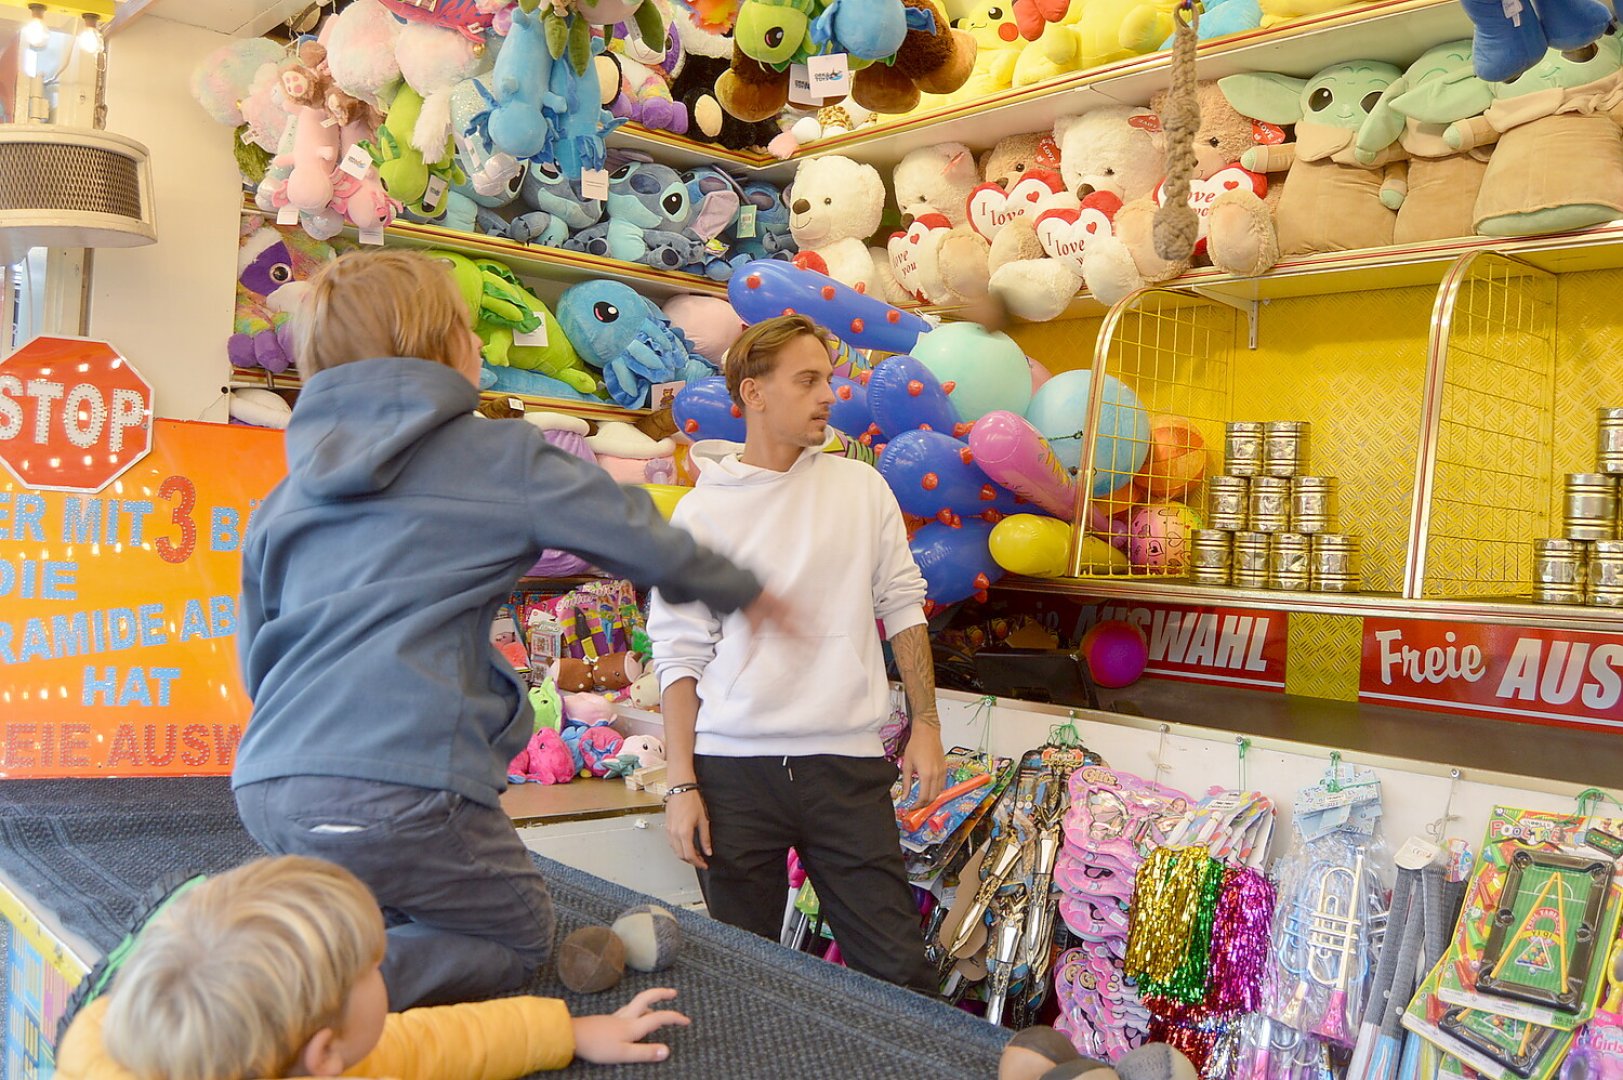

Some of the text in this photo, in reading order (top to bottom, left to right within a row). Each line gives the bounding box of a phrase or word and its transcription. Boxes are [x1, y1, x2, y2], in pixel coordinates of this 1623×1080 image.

[982, 202, 986, 216] I
[1187, 191, 1215, 203] ove
[1047, 232, 1051, 246] I
[1056, 239, 1085, 256] love
[902, 262, 917, 279] you
[0, 375, 145, 453] STOP
[63, 497, 153, 546] MIT
[155, 475, 196, 563] 3
[180, 595, 238, 642] AB
[1073, 604, 1269, 672] AWAHL
[1375, 629, 1486, 685] Freie
[83, 666, 181, 706] HAT
